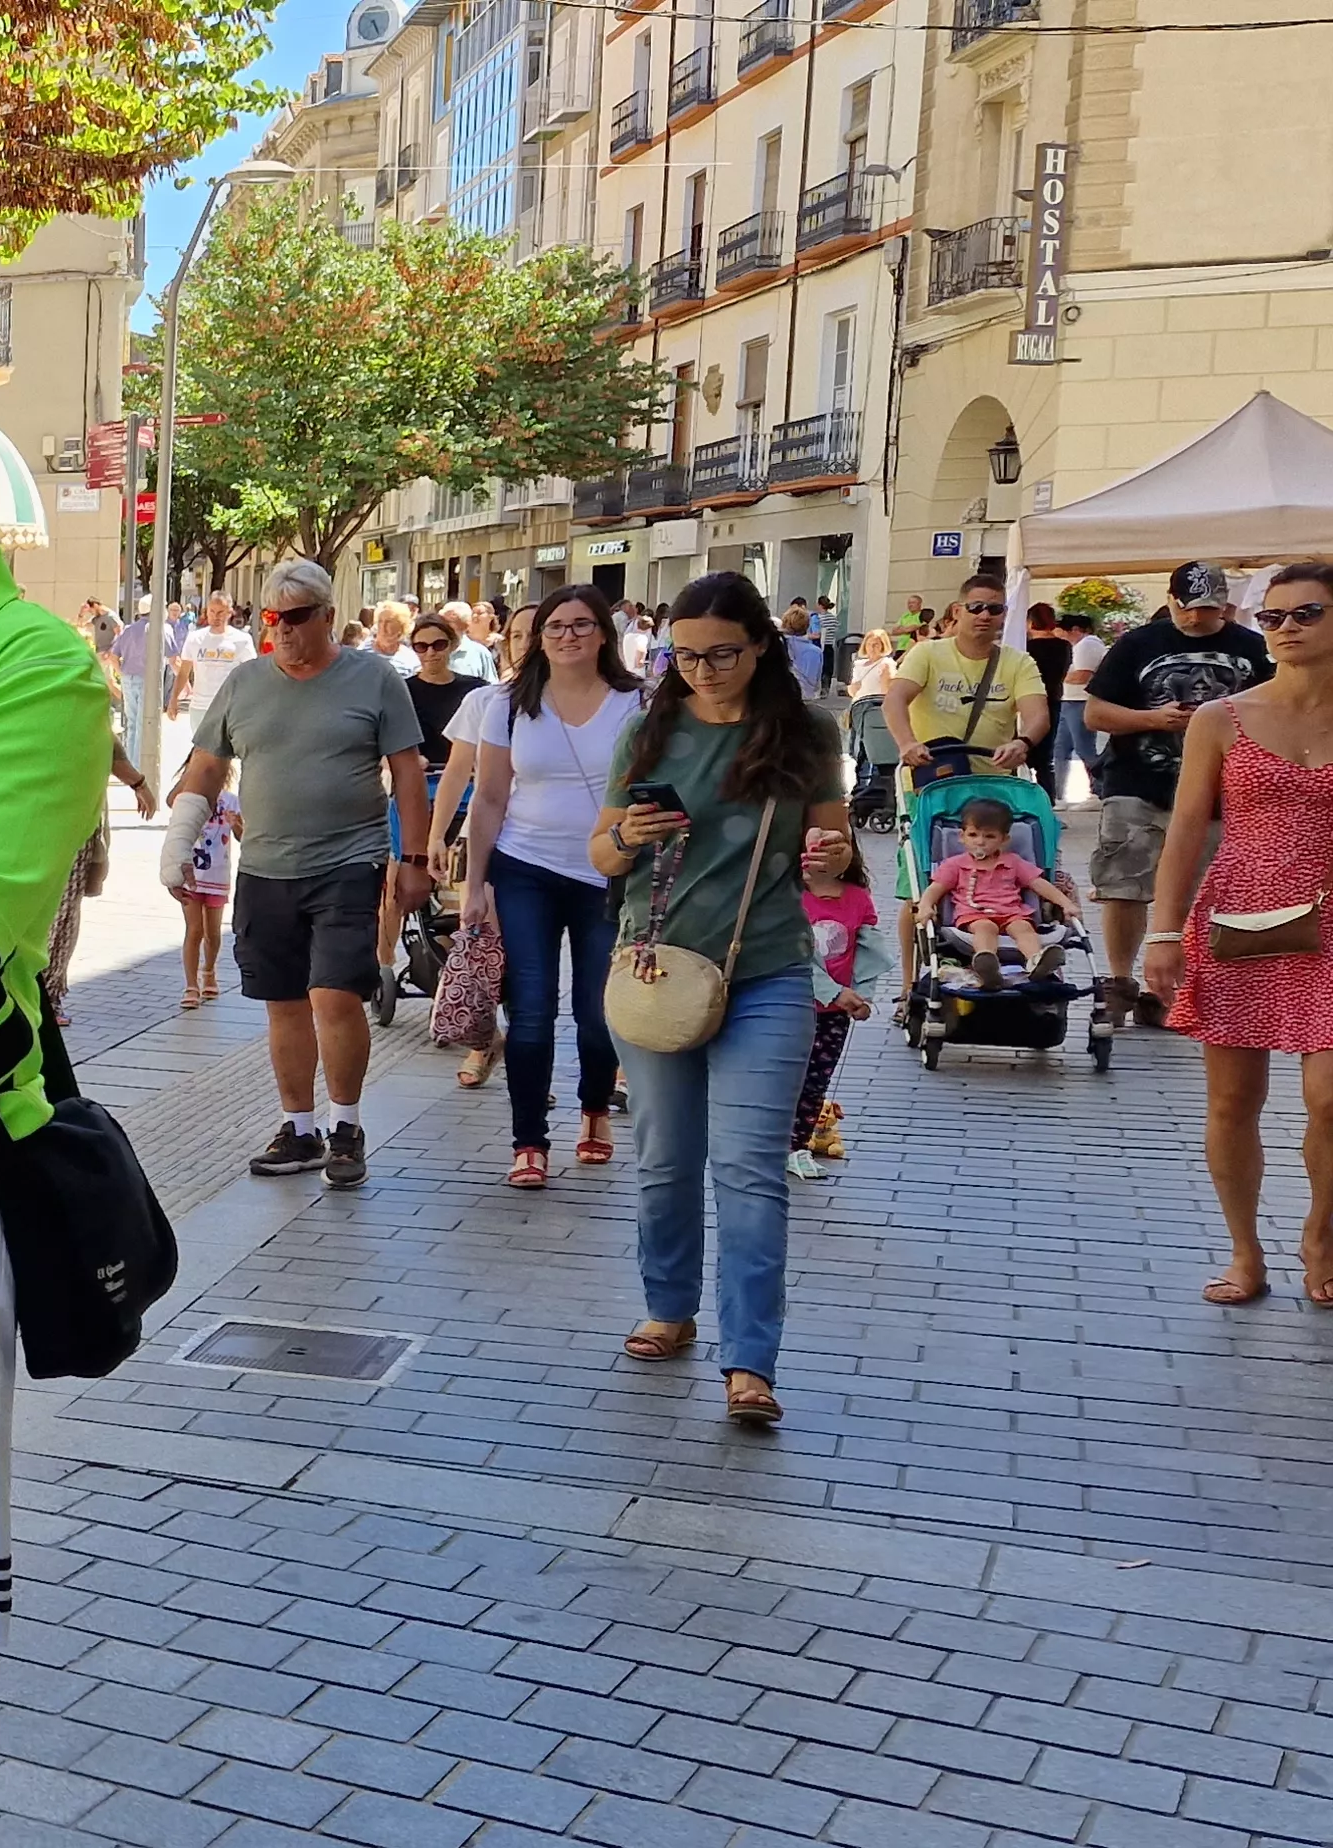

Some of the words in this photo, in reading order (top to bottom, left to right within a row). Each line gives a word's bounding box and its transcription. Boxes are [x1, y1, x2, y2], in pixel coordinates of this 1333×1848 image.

[1034, 148, 1067, 327] HOSTAL
[1015, 333, 1055, 362] RUGACA
[935, 534, 959, 548] HS
[937, 678, 965, 693] Jack
